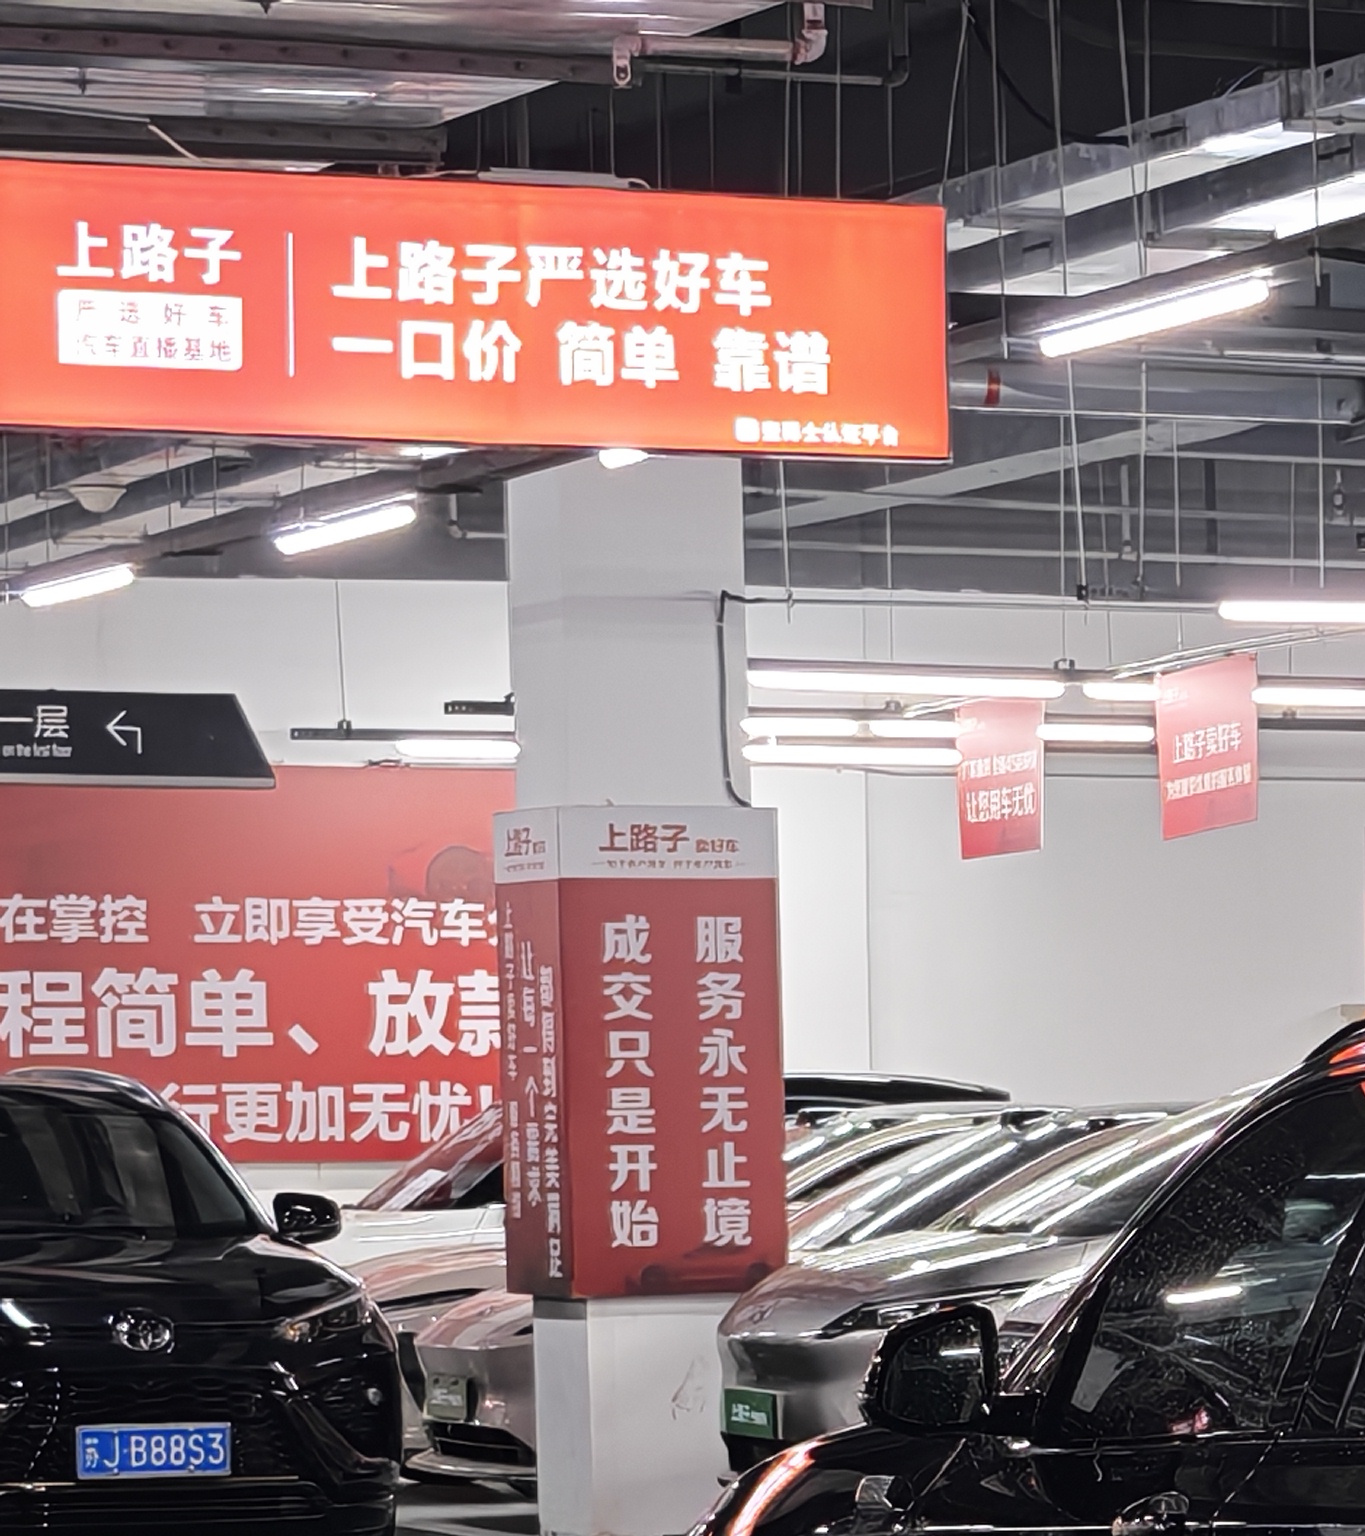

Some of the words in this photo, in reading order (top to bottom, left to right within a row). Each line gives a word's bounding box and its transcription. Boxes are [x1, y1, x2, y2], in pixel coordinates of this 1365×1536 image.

[56, 220, 242, 285] 上路子
[330, 235, 773, 316] 上路子严选好车
[330, 320, 522, 383] 一口价
[558, 323, 681, 390] 简单
[710, 326, 832, 396] 靠谱
[0, 704, 71, 739] 一层
[599, 823, 690, 853] 上路子
[0, 893, 150, 945] 在掌控
[193, 896, 498, 947] 立即享受汽车
[602, 913, 660, 1248] 成交只是开始
[694, 915, 753, 1248] 服务永无止境
